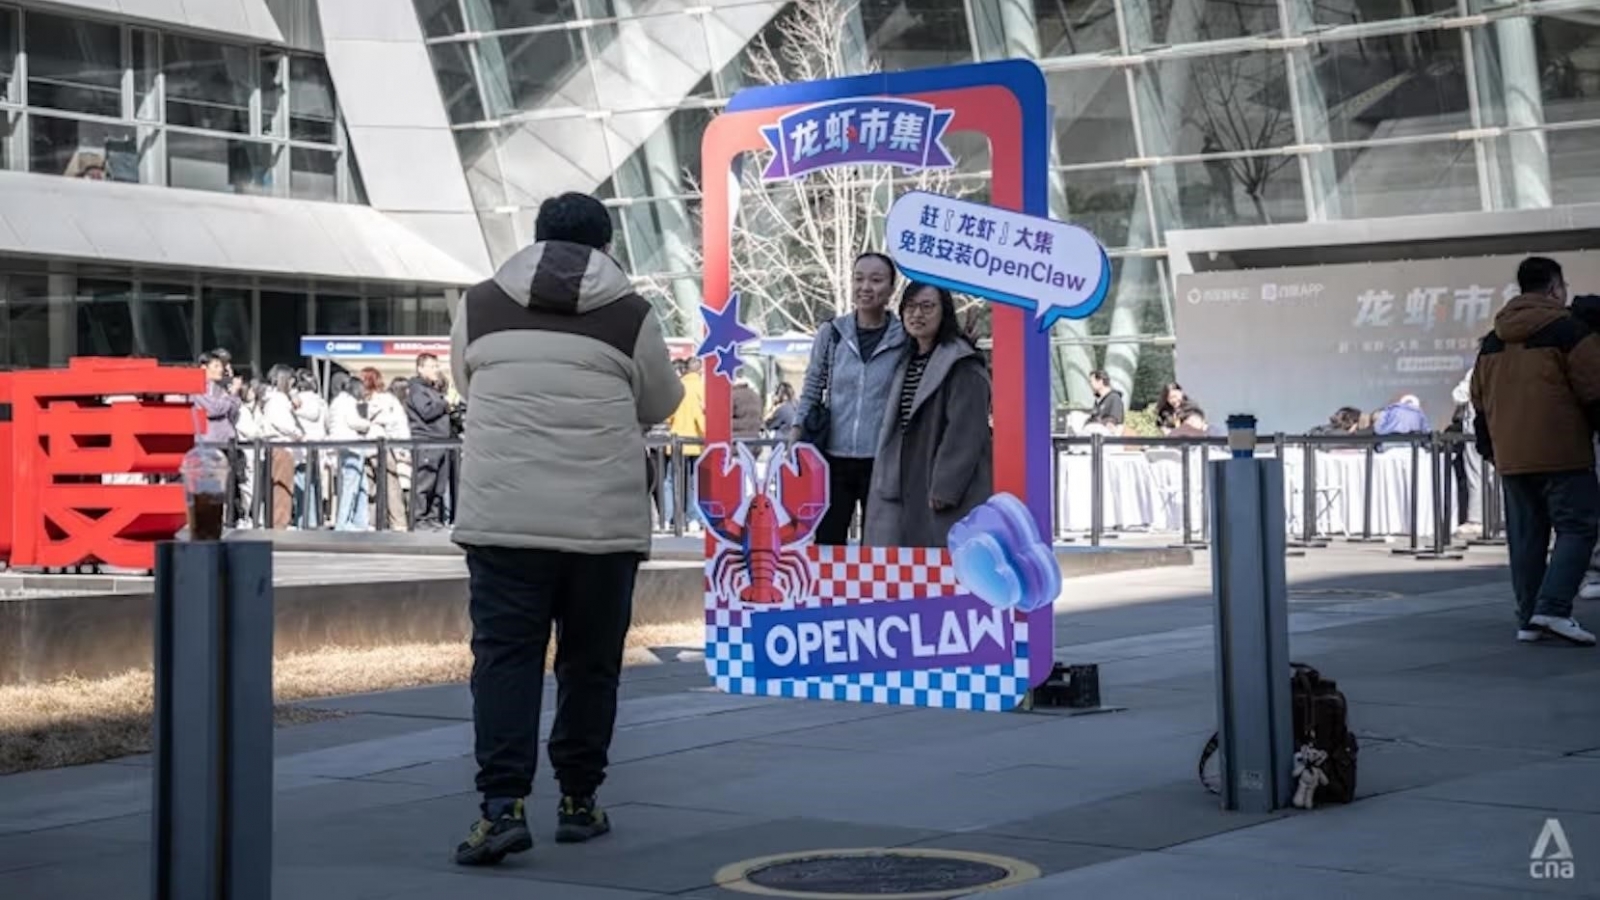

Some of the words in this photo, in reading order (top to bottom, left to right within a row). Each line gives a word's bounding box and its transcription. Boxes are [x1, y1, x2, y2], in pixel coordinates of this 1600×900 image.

[790, 108, 924, 163] 龙虾市集
[899, 229, 1087, 291] 免费安装OpenClaw
[1355, 284, 1521, 333] 龙虾市
[765, 608, 1005, 666] OPENCLAW
